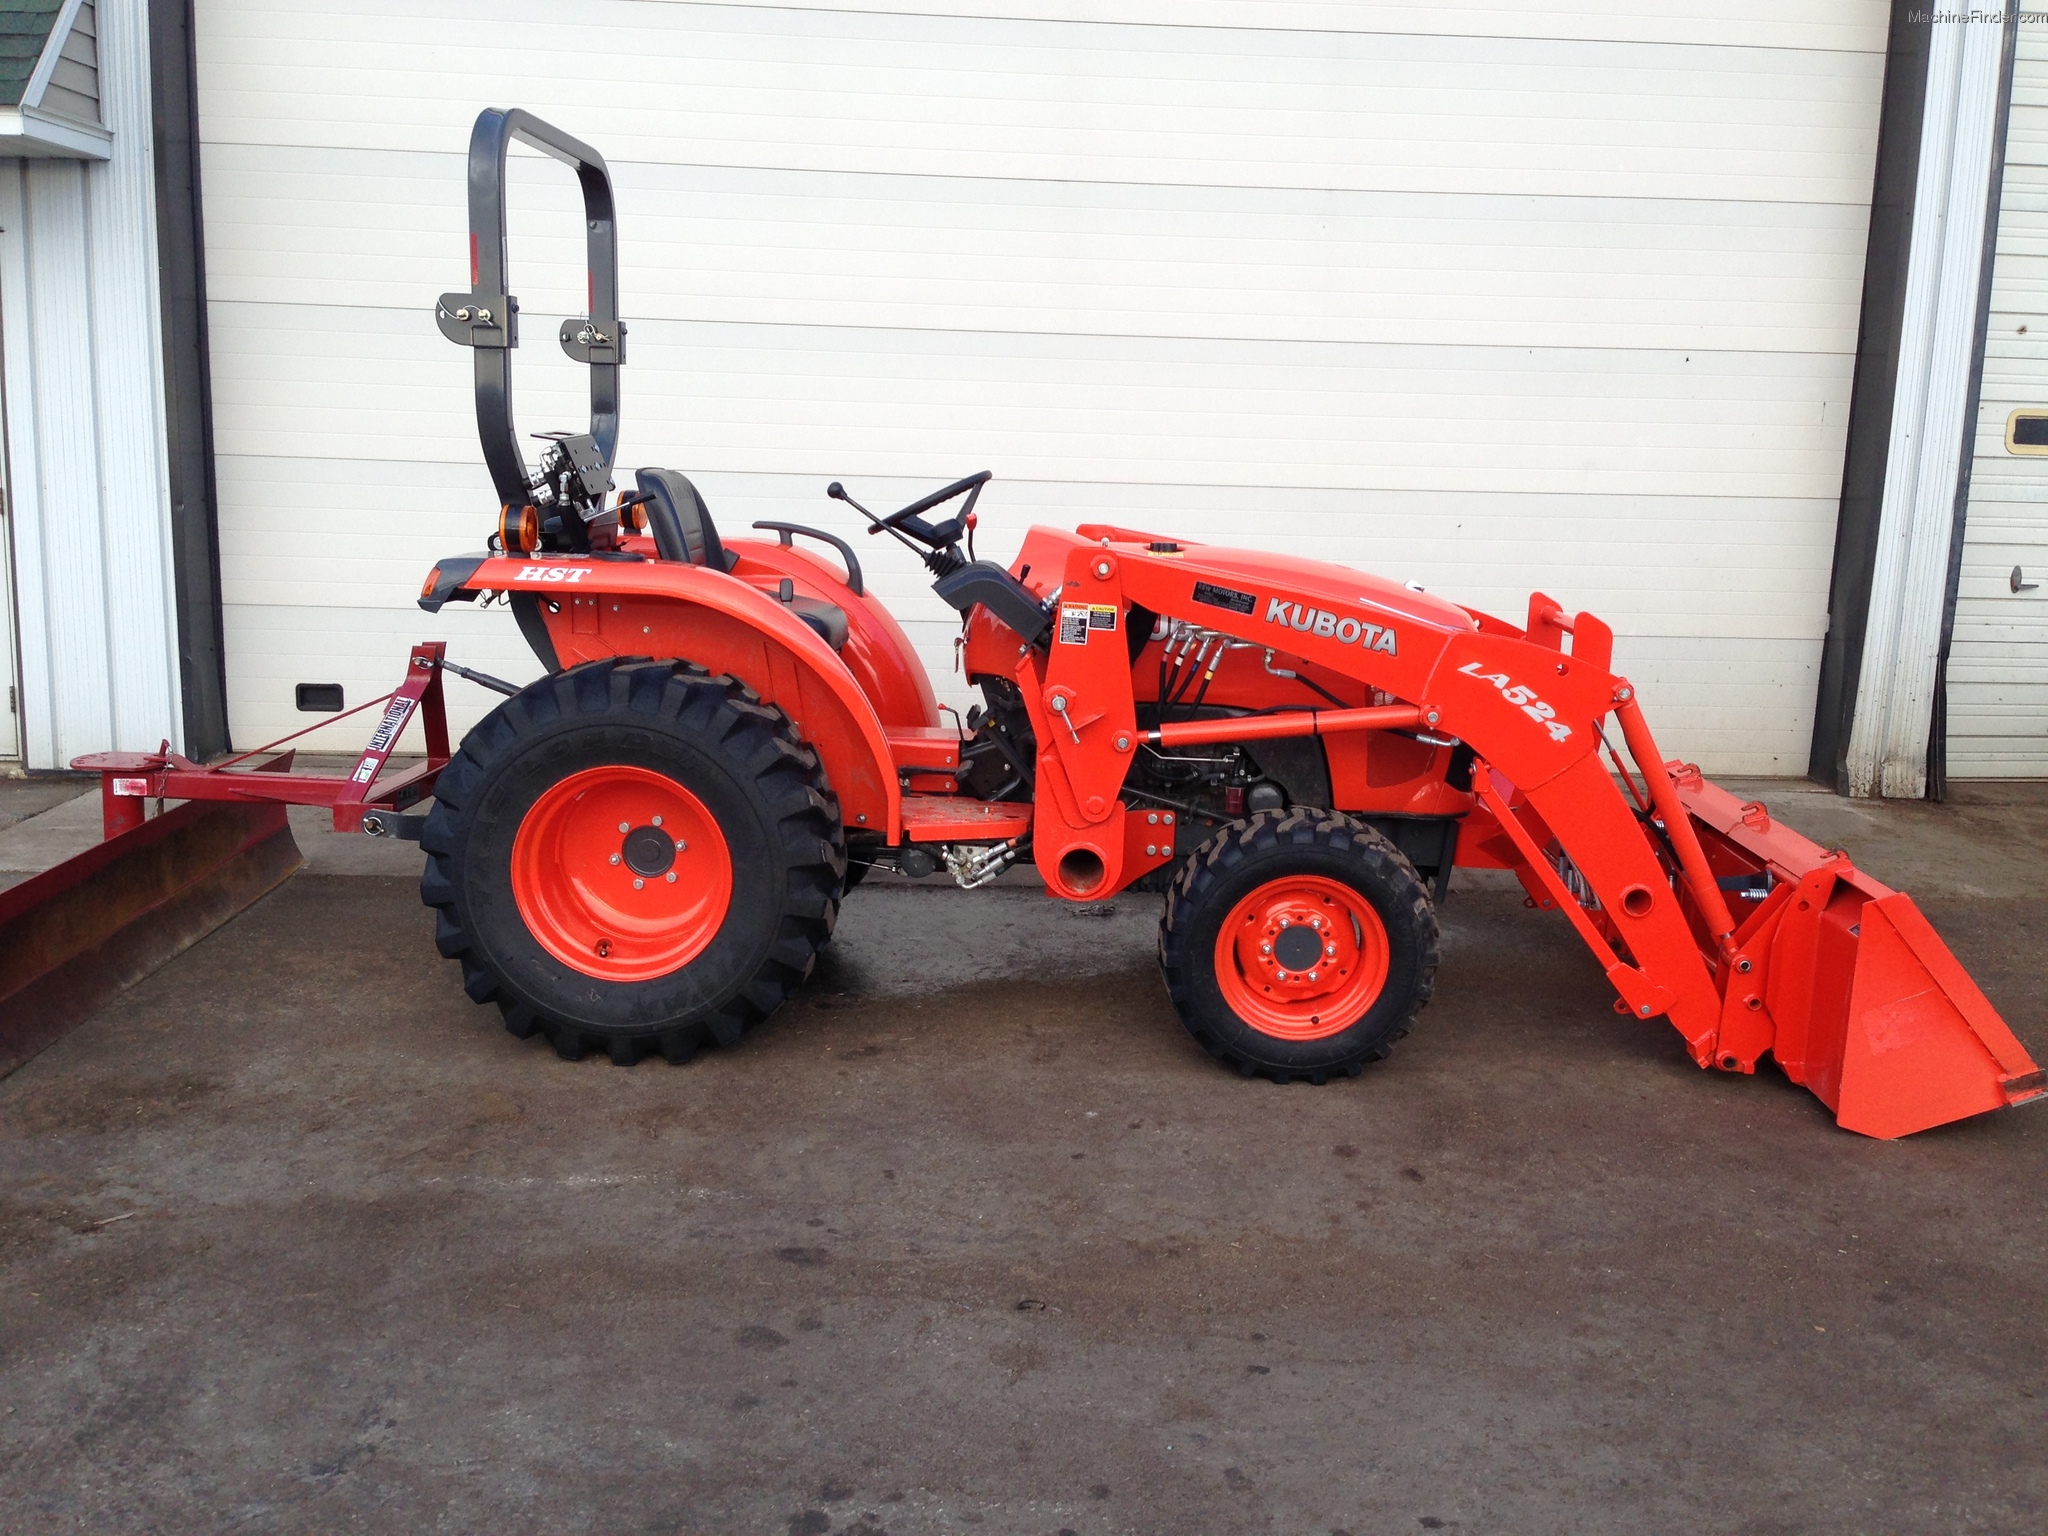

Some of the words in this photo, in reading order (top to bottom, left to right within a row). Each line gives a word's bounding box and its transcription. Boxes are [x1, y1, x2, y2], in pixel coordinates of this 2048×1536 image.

[514, 566, 592, 583] HST
[1264, 596, 1398, 656] KUBOTA
[368, 698, 410, 751] INTERNATIONAL
[1457, 661, 1573, 743] LA524
